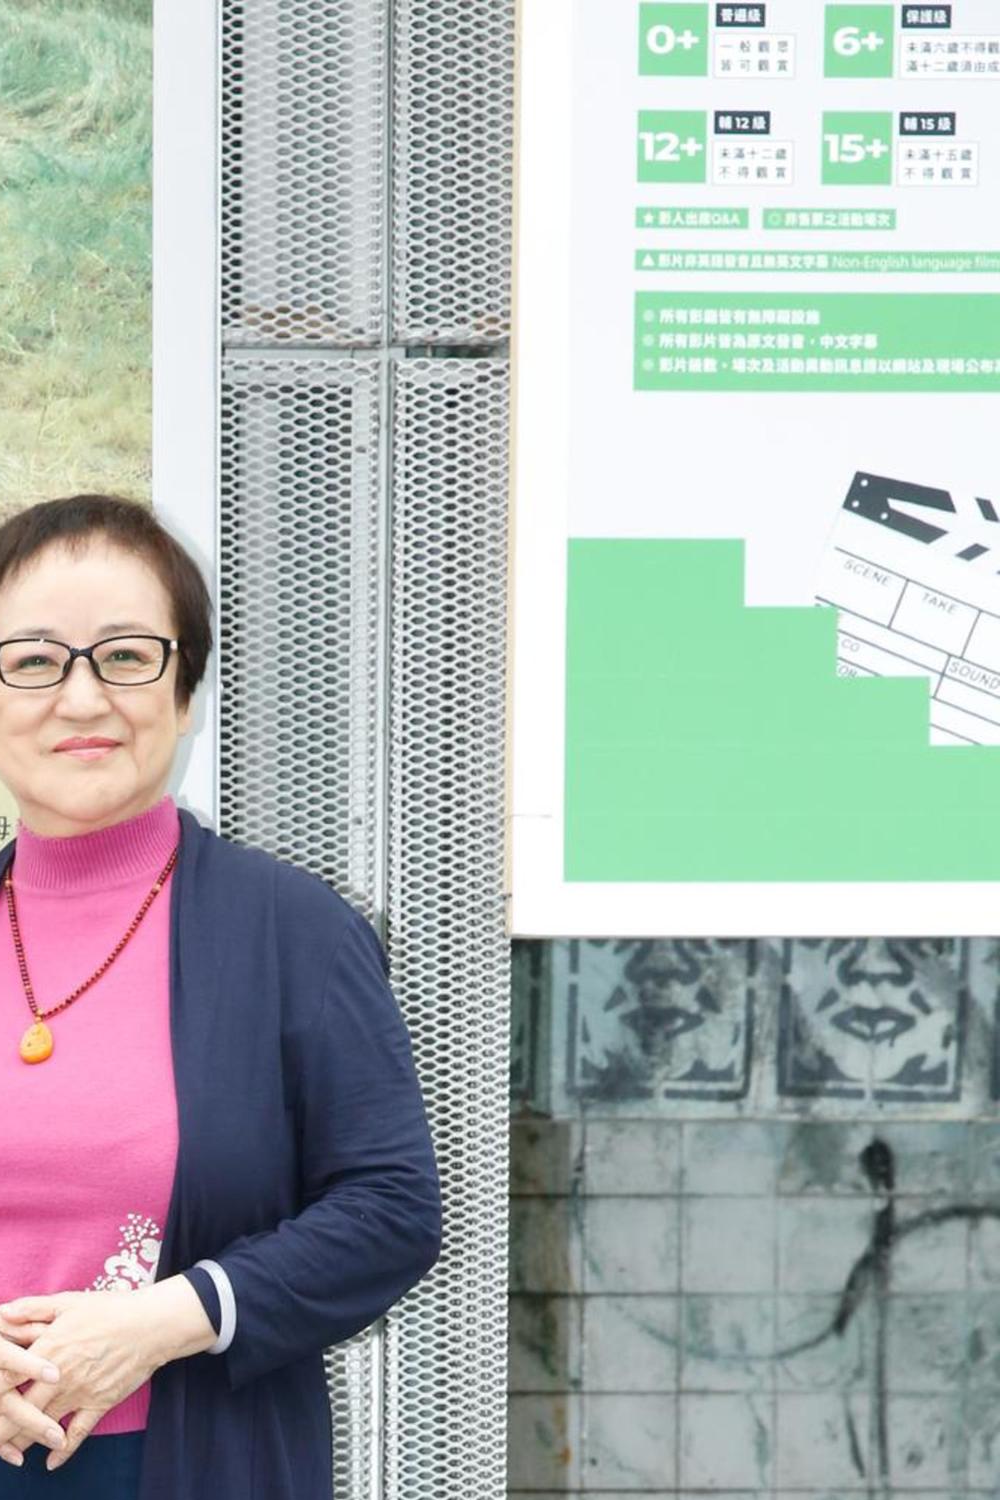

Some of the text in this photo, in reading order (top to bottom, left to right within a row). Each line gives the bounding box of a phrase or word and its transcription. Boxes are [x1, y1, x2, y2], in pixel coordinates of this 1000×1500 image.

[646, 24, 699, 54] 0+
[833, 27, 884, 56] 6+
[638, 131, 703, 162] 12+
[720, 147, 787, 160] 未滿十二歲
[823, 133, 889, 164] 15+
[719, 166, 787, 180] 不得觀賞
[904, 167, 972, 180] 不得觀賞
[843, 559, 892, 587] SCENE
[922, 592, 957, 616] TAKE
[949, 661, 1000, 690] SOUND
